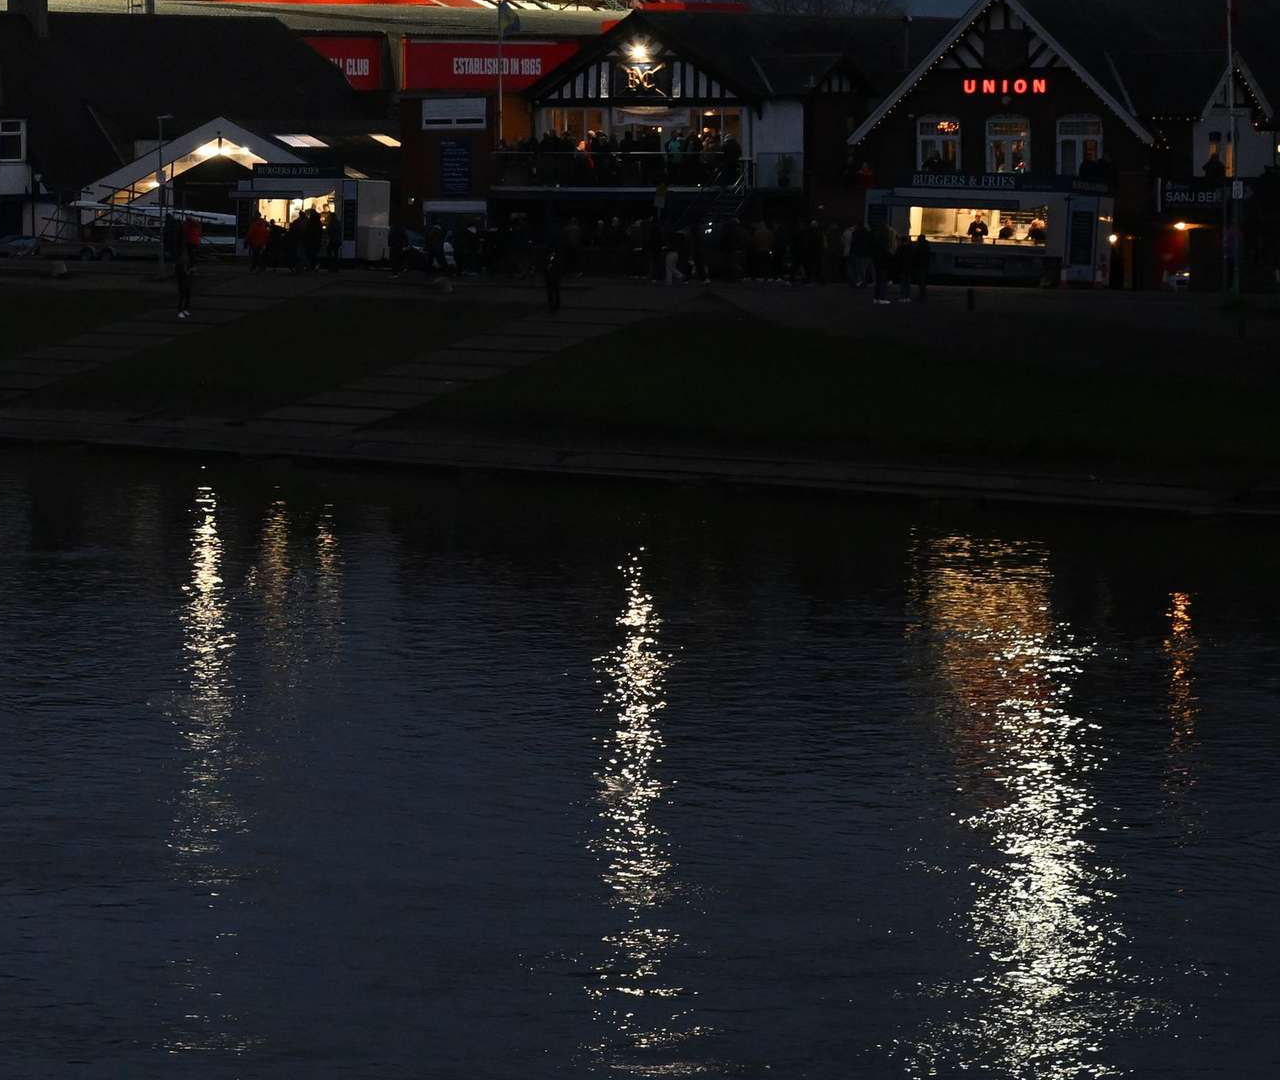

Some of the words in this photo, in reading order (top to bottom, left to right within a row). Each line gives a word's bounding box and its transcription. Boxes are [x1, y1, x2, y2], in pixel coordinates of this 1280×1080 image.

[346, 58, 370, 76] CLUB
[510, 57, 520, 75] IN
[521, 57, 541, 75] 1865
[963, 79, 1046, 94] UNION
[912, 174, 966, 186] BURGERS
[969, 176, 977, 186] &
[981, 175, 1017, 187] FRIES
[1166, 191, 1195, 201] SANJ
